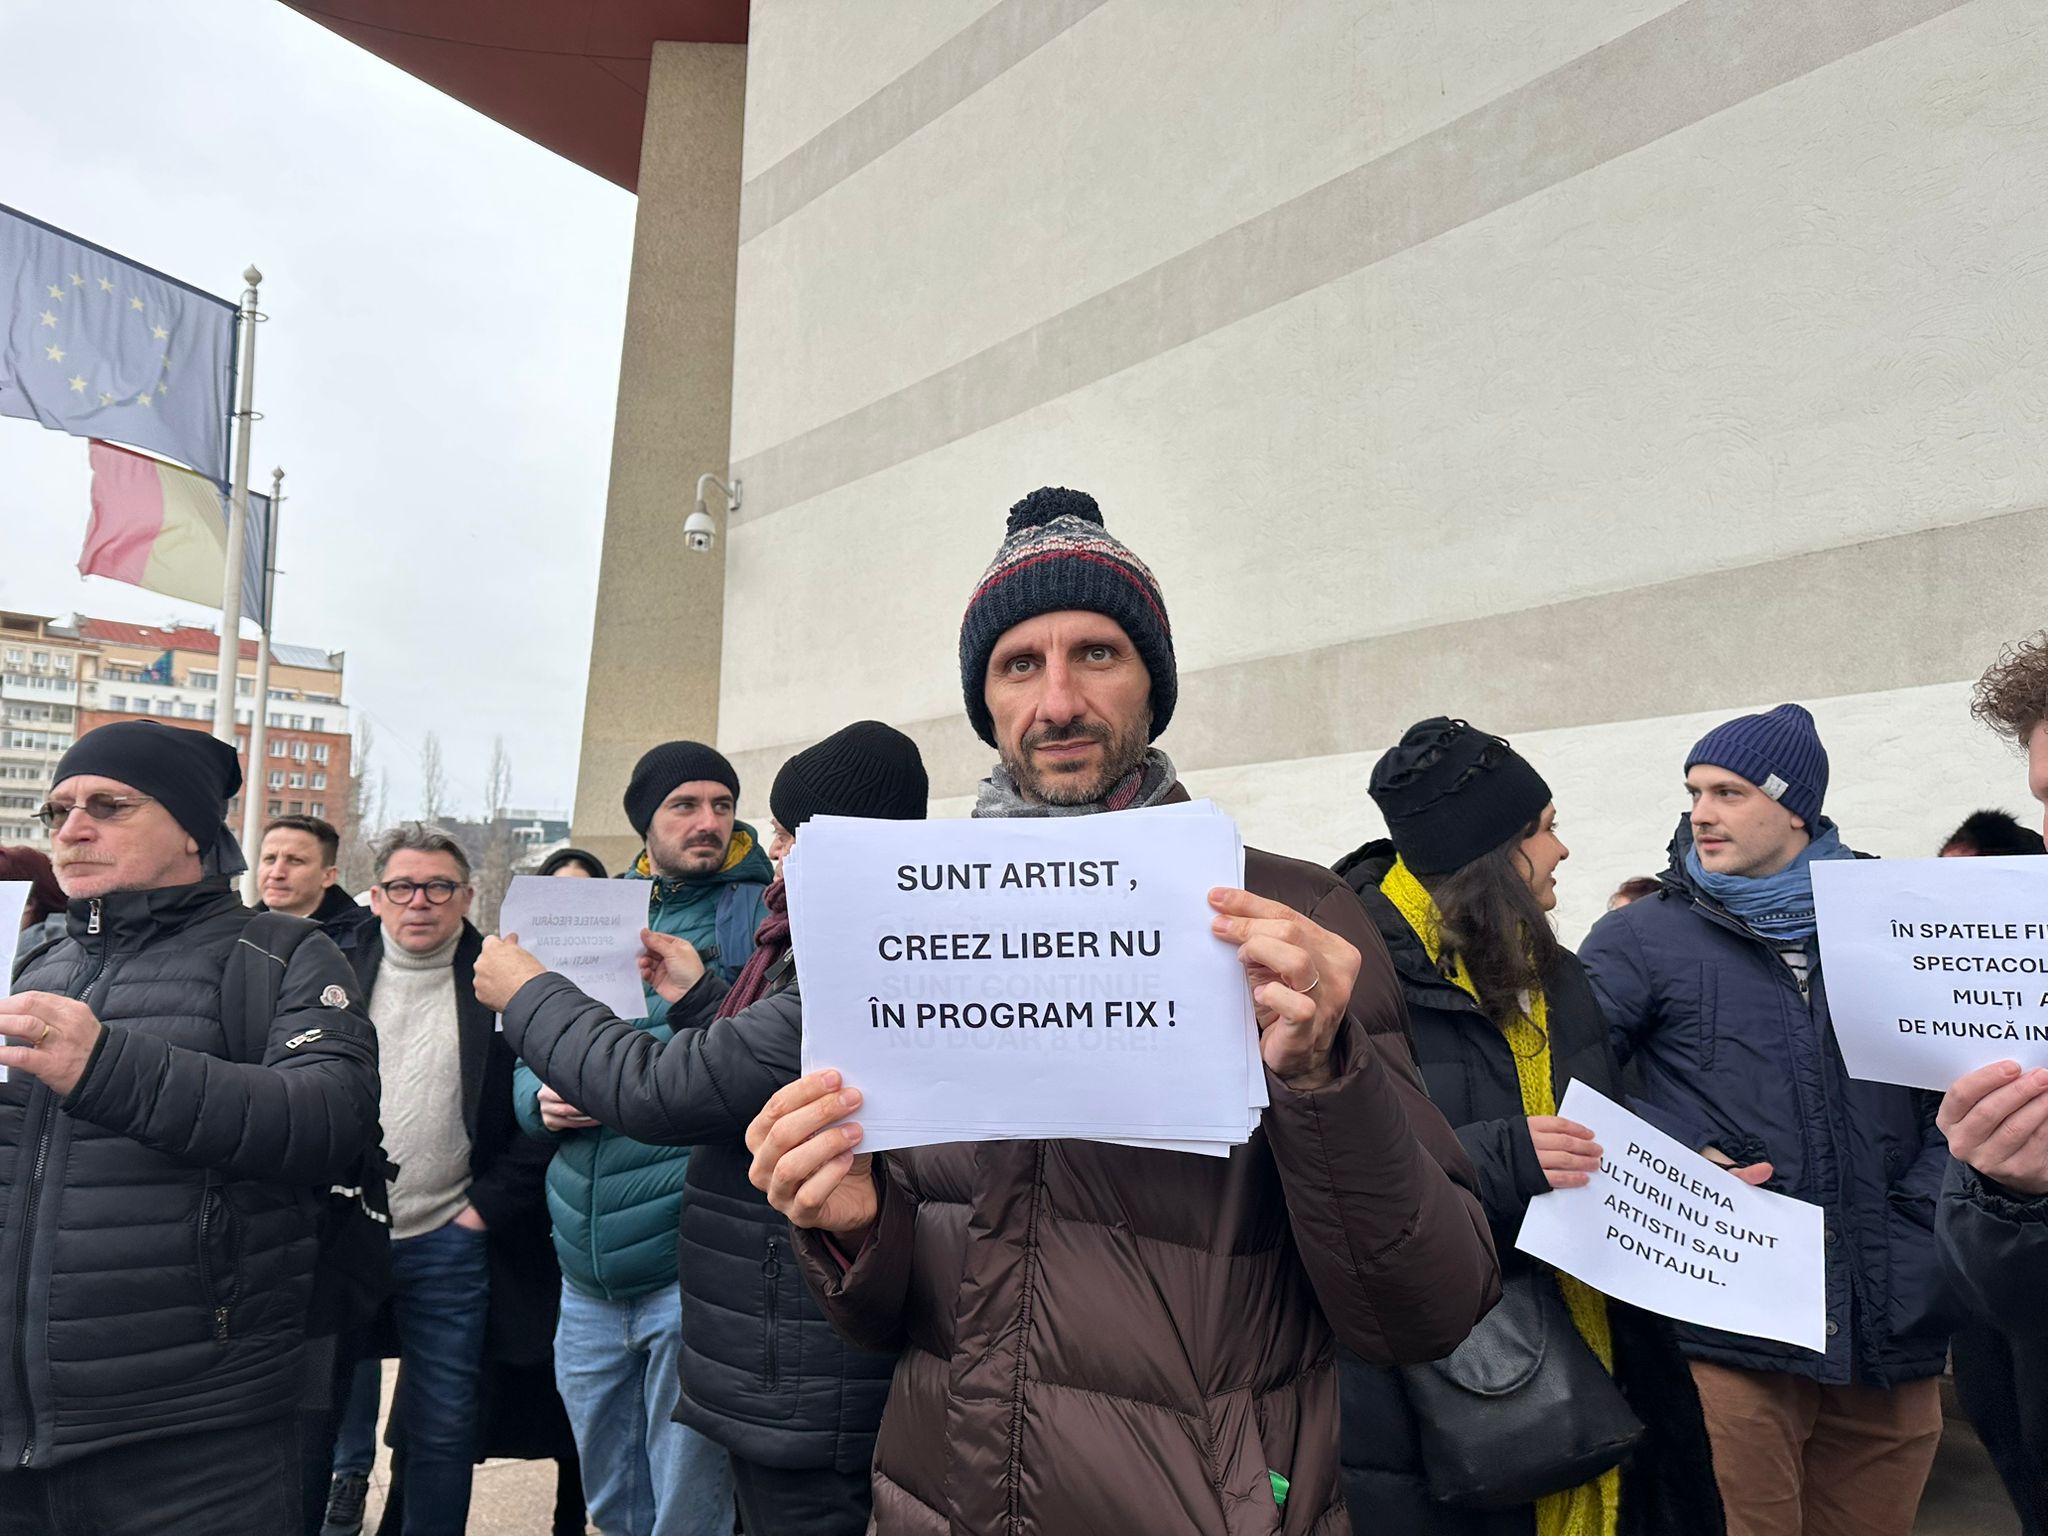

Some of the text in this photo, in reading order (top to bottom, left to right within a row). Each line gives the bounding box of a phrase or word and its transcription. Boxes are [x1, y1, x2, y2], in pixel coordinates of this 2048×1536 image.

[897, 863, 992, 892] SUNT
[999, 860, 1119, 889] ARTIST
[878, 933, 992, 962] CREEZ
[1001, 931, 1100, 960] LIBER
[1110, 929, 1161, 958] NU
[1889, 919, 2048, 940] ÎN SPATELE FI
[1912, 955, 2048, 974] SPECTACOL
[867, 996, 906, 1029] ÎN
[916, 1001, 1093, 1029] PROGRAM
[1105, 1000, 1159, 1028] FIX
[1953, 989, 2022, 1010] MULȚI
[1898, 1018, 1927, 1035] DE
[1932, 1020, 2020, 1041] MUNCĂ
[1626, 1141, 1734, 1212] PROBLEMA
[1600, 1156, 1779, 1249] ULTURII NU SUNT
[1604, 1194, 1739, 1263] ARTISTII SAU
[1606, 1225, 1727, 1287] PONTAJUL.
